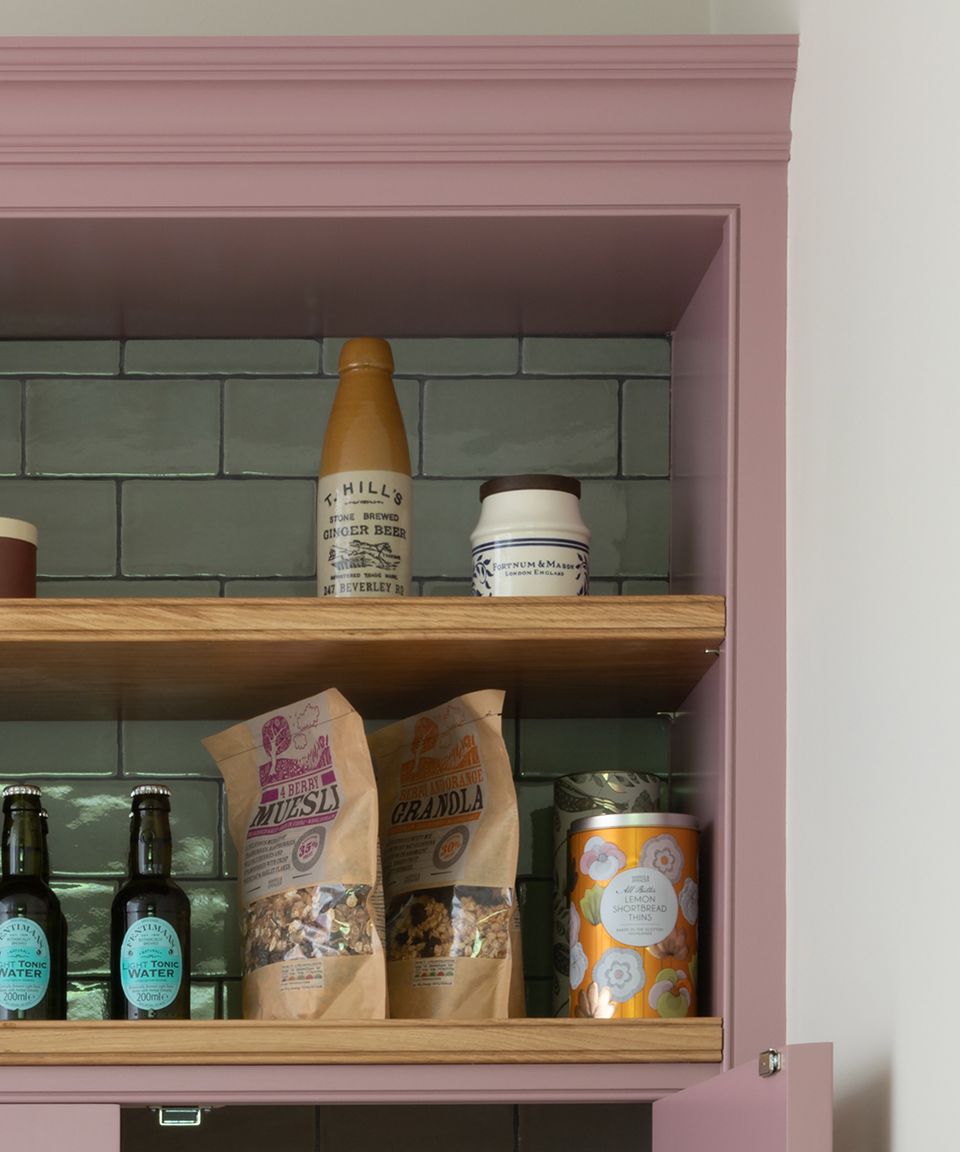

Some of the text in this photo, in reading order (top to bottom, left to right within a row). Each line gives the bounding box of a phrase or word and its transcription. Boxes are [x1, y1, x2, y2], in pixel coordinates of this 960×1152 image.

[343, 480, 403, 506] HILL'S
[330, 512, 400, 524] STONE BREWED
[323, 525, 407, 540] GINGER BEER
[493, 560, 536, 571] FORTNUM
[538, 560, 546, 568] &
[534, 569, 565, 577] ENGLAND
[340, 582, 392, 594] BEVERLEY
[279, 776, 319, 799] 4 BERRY
[391, 784, 483, 826] GRANOLA
[625, 895, 656, 904] LEMON
[612, 904, 667, 913] SHORTBREAD
[628, 912, 653, 922] THINS
[18, 960, 47, 969] TONIC
[123, 960, 179, 970] LIGHT TONIC
[128, 969, 174, 978] WATER
[3, 992, 27, 1001] 200ml
[136, 992, 161, 1001] 200ml
